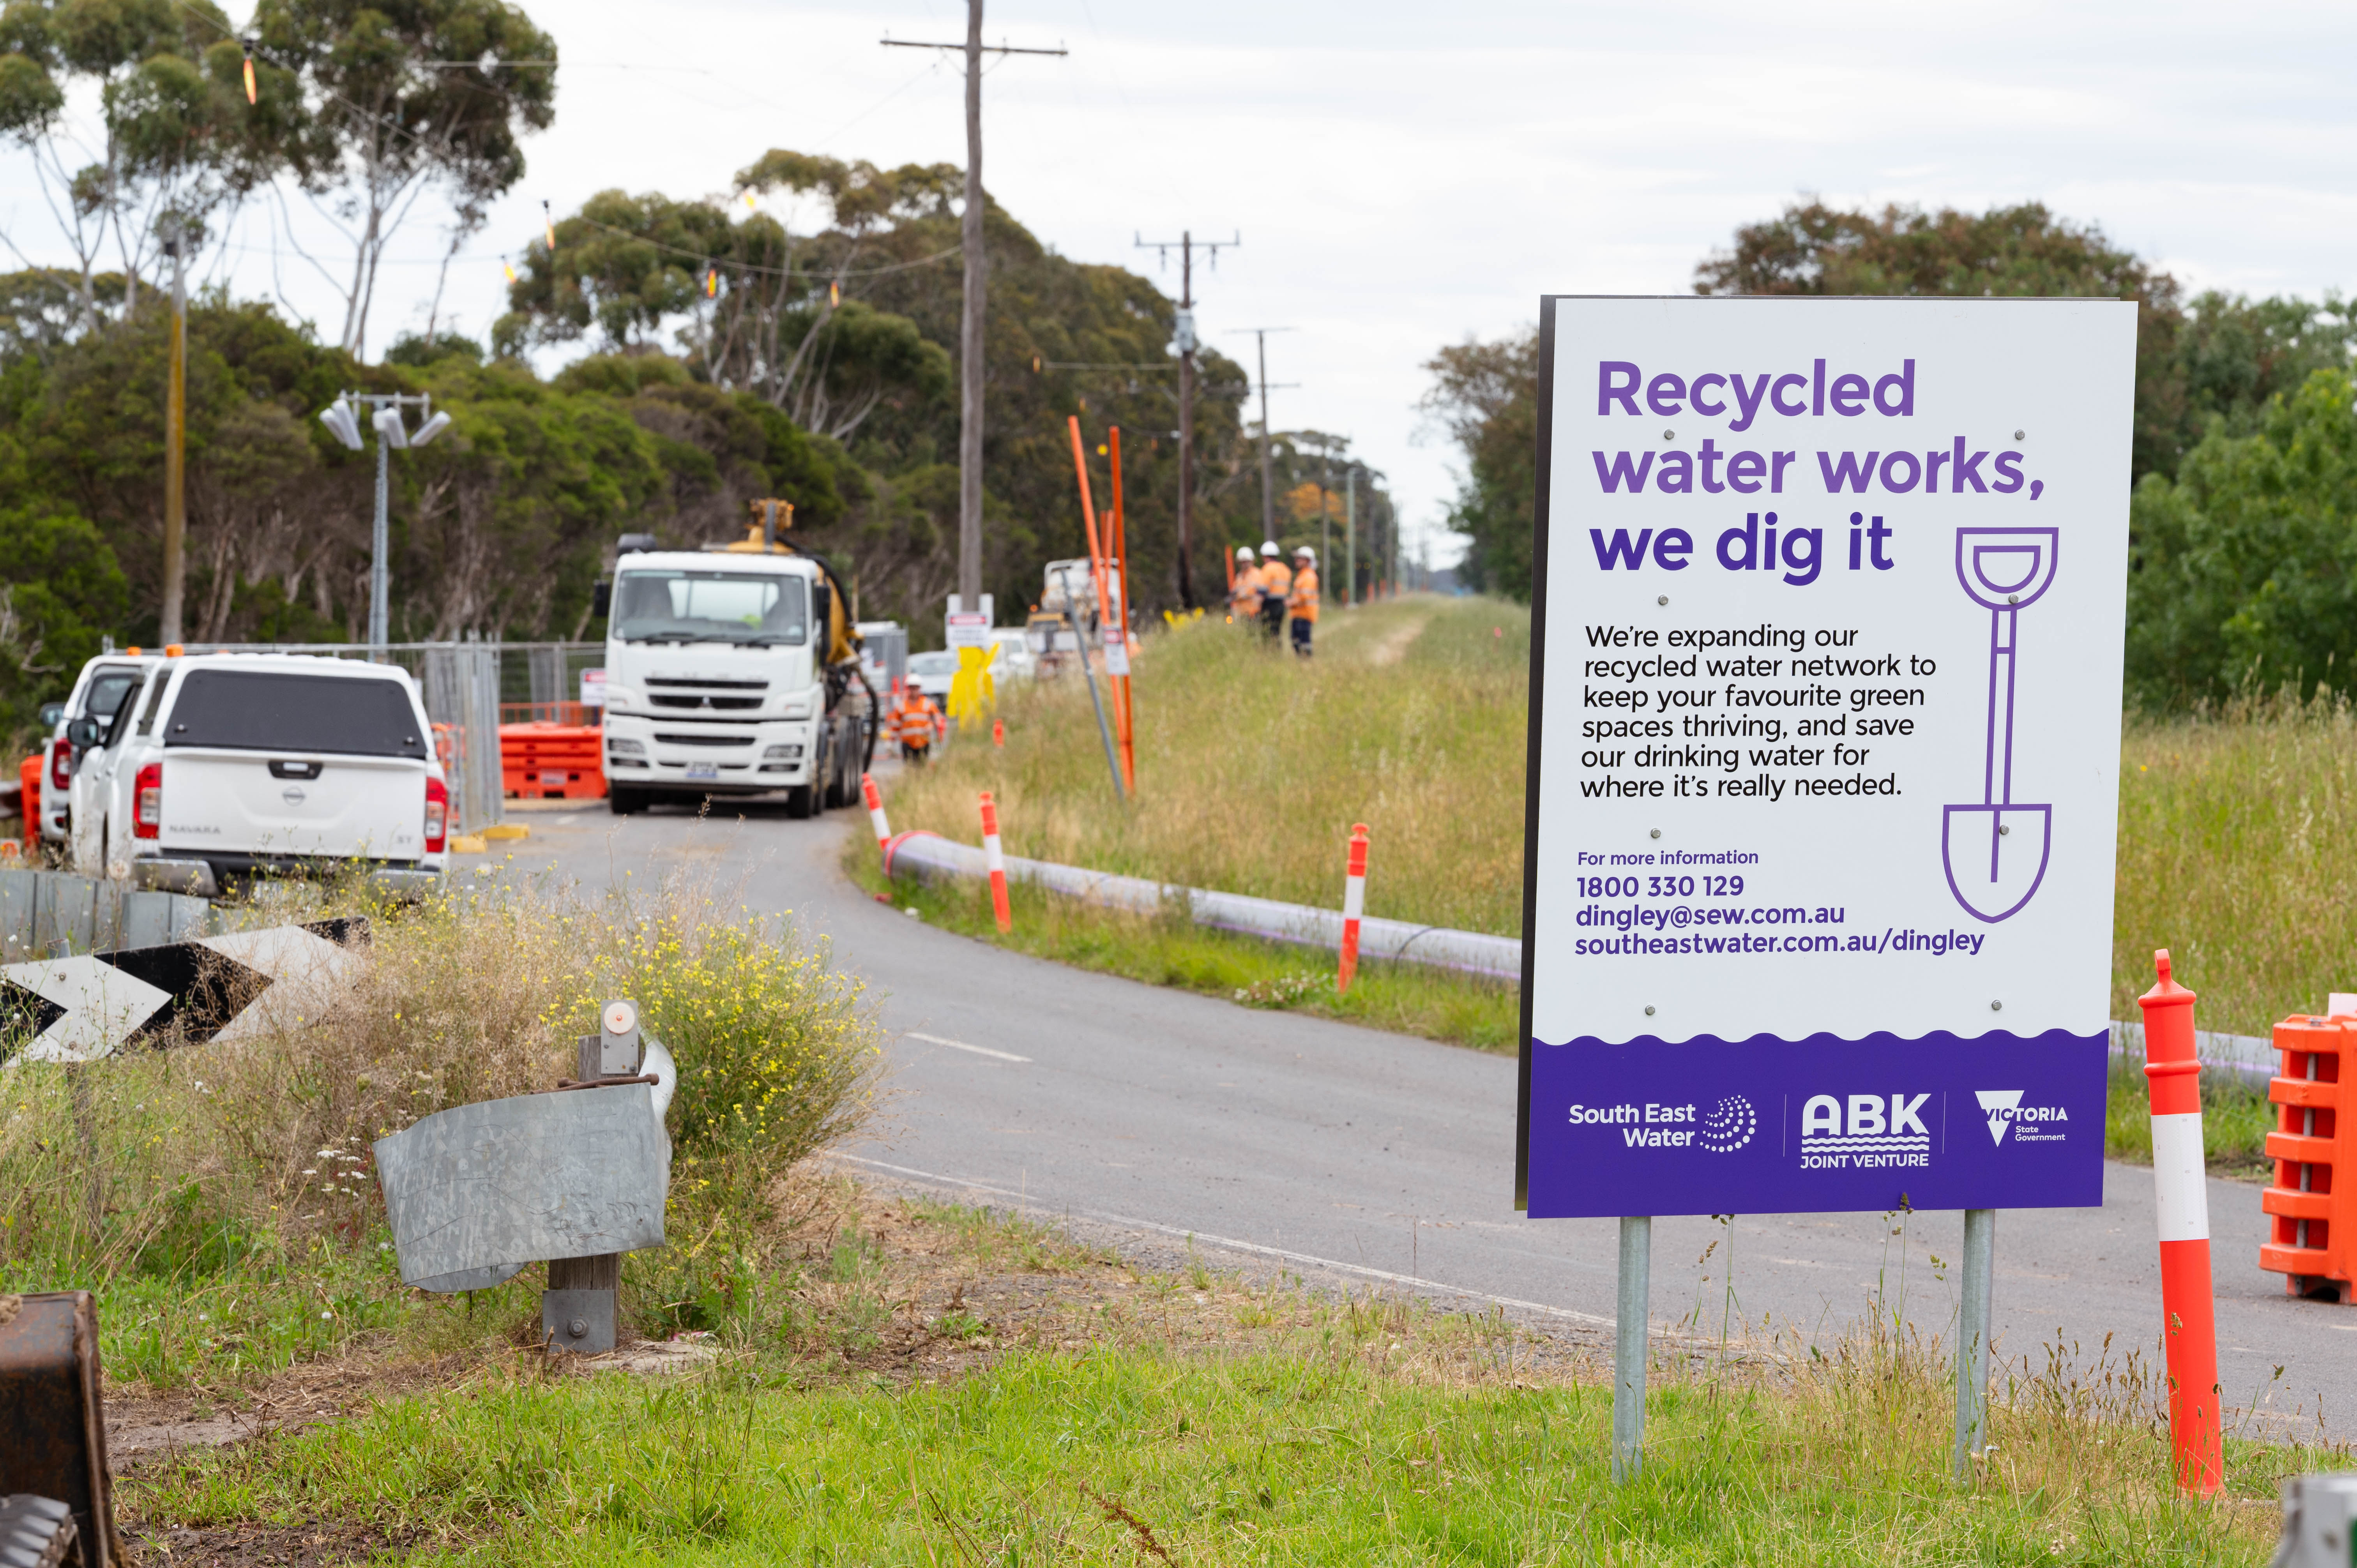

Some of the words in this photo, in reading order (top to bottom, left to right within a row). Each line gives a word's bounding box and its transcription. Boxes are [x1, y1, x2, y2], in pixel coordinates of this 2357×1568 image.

[1597, 358, 1915, 433] Recycled
[1591, 438, 1796, 494] water
[1816, 436, 2044, 501] works,
[1588, 527, 1694, 571] we
[1716, 511, 1823, 586] dig
[1848, 511, 1895, 571] it
[1667, 623, 1805, 653] expanding
[1815, 629, 1859, 647] our
[1585, 654, 1697, 684] recycled
[1705, 655, 1783, 677] water
[1791, 653, 1901, 677] network
[1910, 654, 1936, 676] to
[1584, 684, 1649, 713] keep
[1656, 690, 1717, 713] your
[1724, 683, 1841, 707] favourite
[1850, 689, 1924, 713] green
[1581, 720, 1673, 743] spaces
[1682, 713, 1788, 743] thriving,
[1797, 713, 1846, 736] and
[1855, 719, 1914, 736] save
[1581, 750, 1626, 768] our
[1634, 743, 1739, 773] drinking
[1748, 744, 1825, 766] water
[1833, 742, 1870, 766] for
[1580, 774, 1664, 798] where
[1717, 773, 1786, 802] really
[1795, 772, 1902, 796] needed.
[168, 824, 222, 835] NAVARA
[1578, 851, 1606, 866] For
[1610, 854, 1655, 865] more
[1660, 849, 1759, 865] information
[1576, 876, 1639, 898] 1800
[1647, 876, 1695, 897] 330
[1703, 875, 1744, 897] 129
[1576, 904, 1845, 932] dingley@sew.com.au
[1574, 927, 1986, 956] southeastwater.com.au/dingley
[1568, 1104, 1640, 1124] South
[1645, 1103, 1696, 1123] East
[1802, 1093, 1931, 1137] ABK
[1982, 1107, 2069, 1122] VICTORIA
[1622, 1128, 1695, 1147] Water
[2015, 1133, 2066, 1142] Government
[1800, 1155, 1850, 1169] JOINT
[1852, 1153, 1929, 1168] VENTURE
